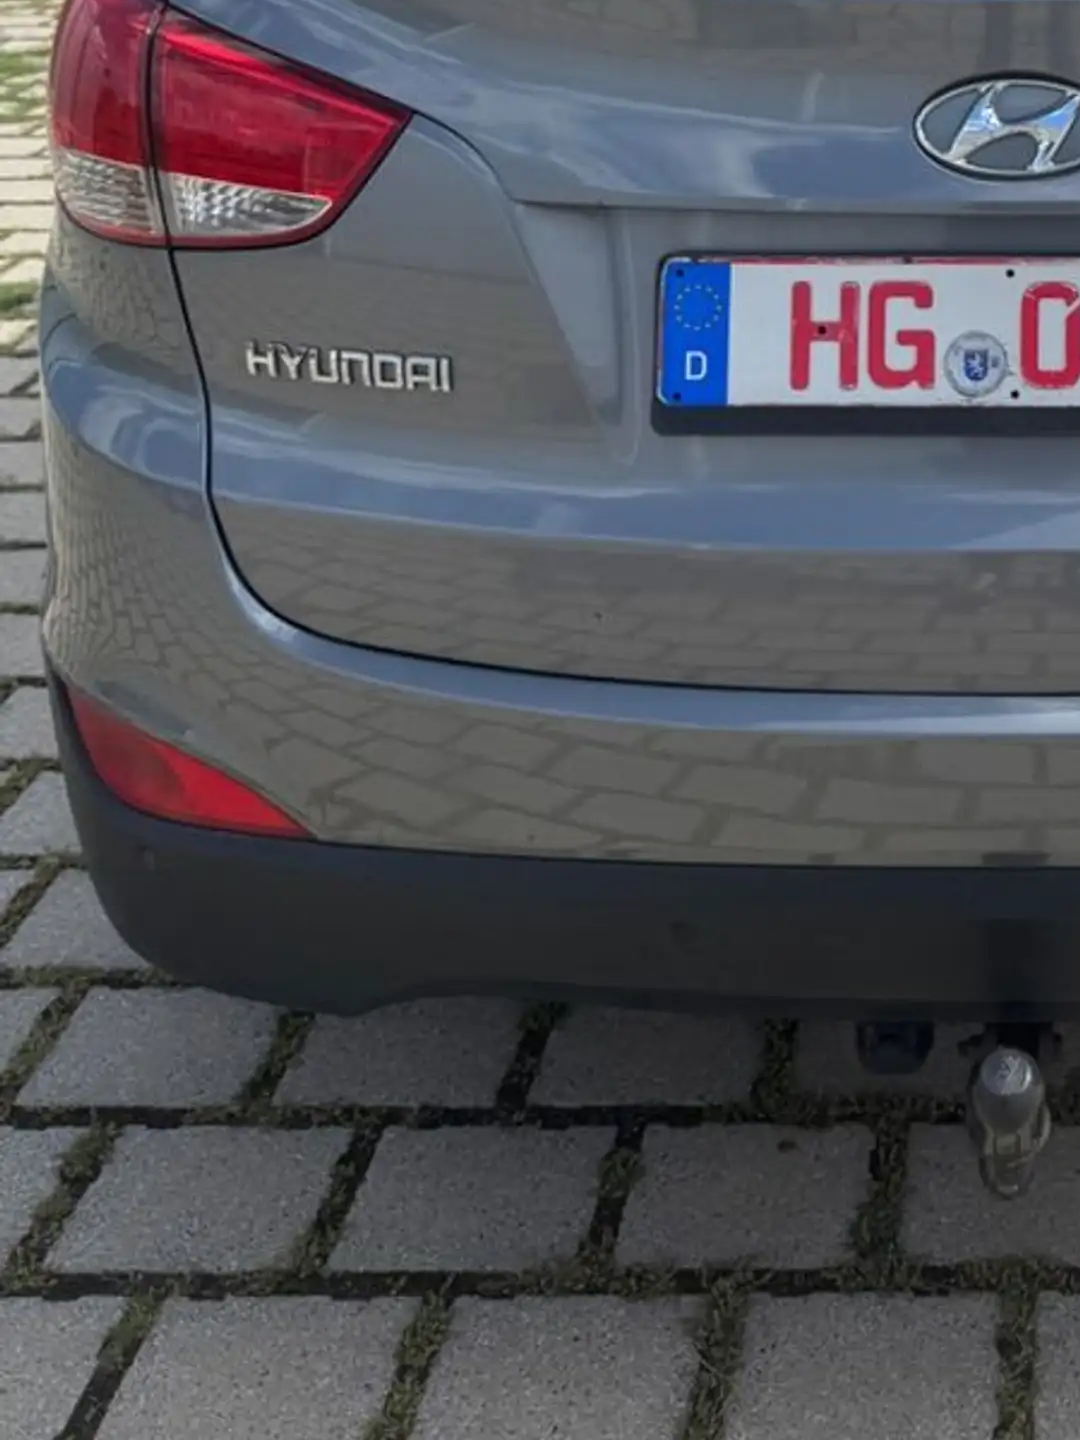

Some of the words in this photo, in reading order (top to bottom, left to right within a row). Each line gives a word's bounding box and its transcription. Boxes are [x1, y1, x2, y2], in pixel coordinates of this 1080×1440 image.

[788, 279, 936, 392] HG
[244, 341, 453, 393] HYUNDAI
[684, 349, 708, 381] D
